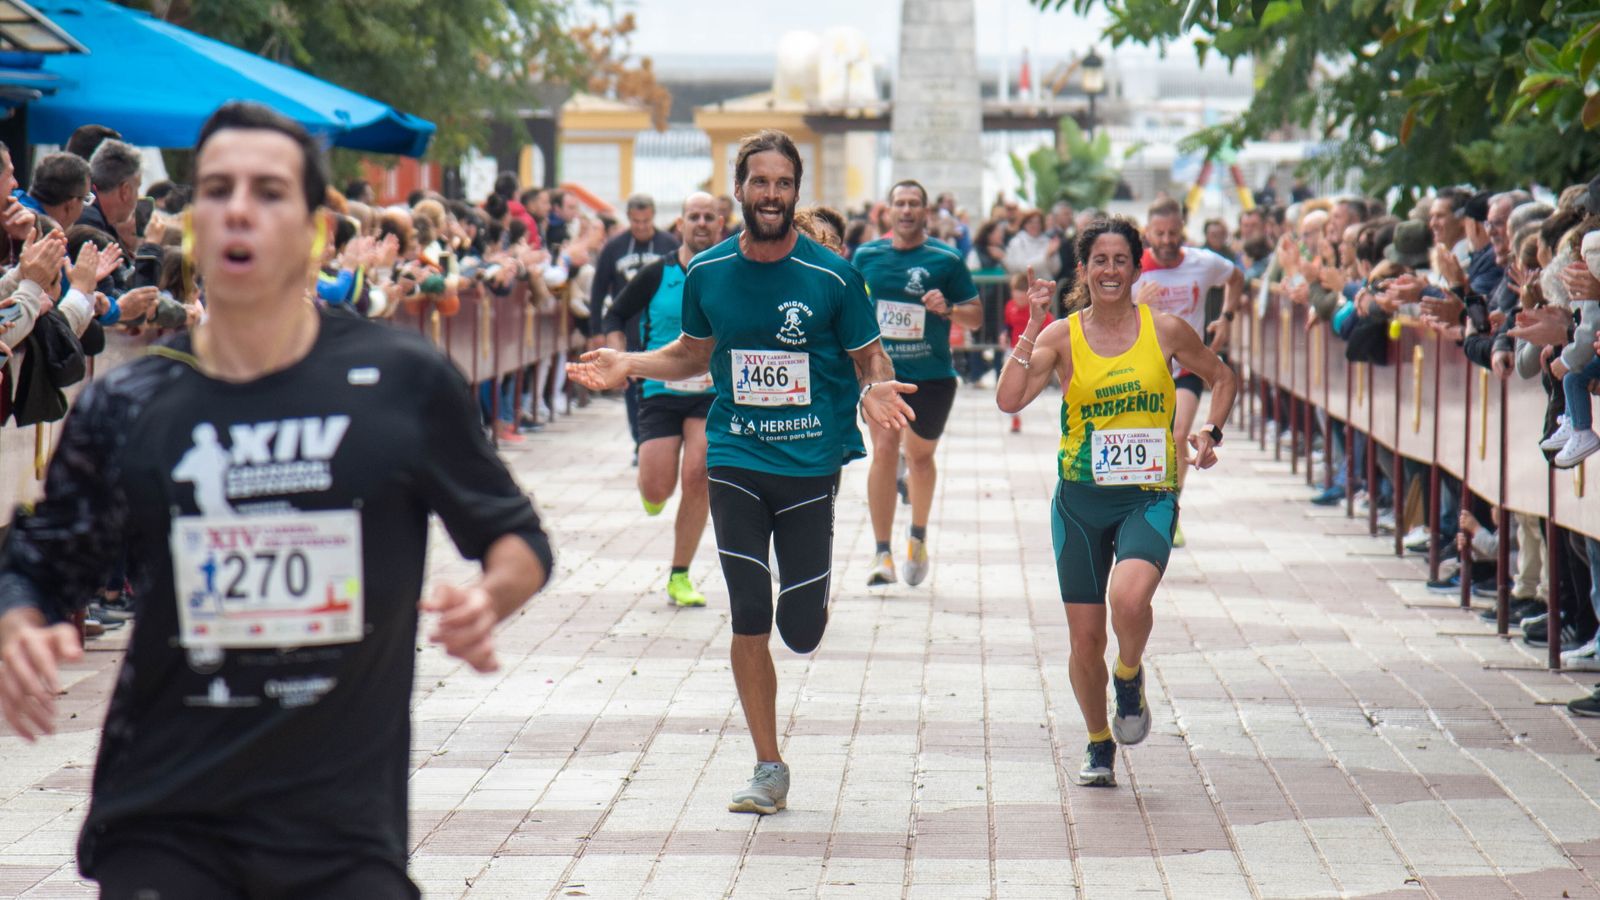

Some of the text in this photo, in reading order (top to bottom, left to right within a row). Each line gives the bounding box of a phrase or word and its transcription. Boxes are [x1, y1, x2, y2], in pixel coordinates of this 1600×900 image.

[778, 301, 813, 317] BRIGADA
[888, 311, 912, 327] 296
[775, 333, 807, 345] EMPUJE
[744, 354, 766, 365] XIV
[750, 366, 788, 387] 466
[1095, 380, 1141, 399] RUNNERS
[760, 413, 821, 432] HERRERÍA
[228, 415, 351, 467] XIV
[789, 433, 805, 441] para
[806, 430, 823, 438] llevar
[1104, 434, 1126, 445] XIV
[1110, 444, 1146, 466] 219
[206, 527, 262, 550] XIV
[222, 548, 310, 600] 270
